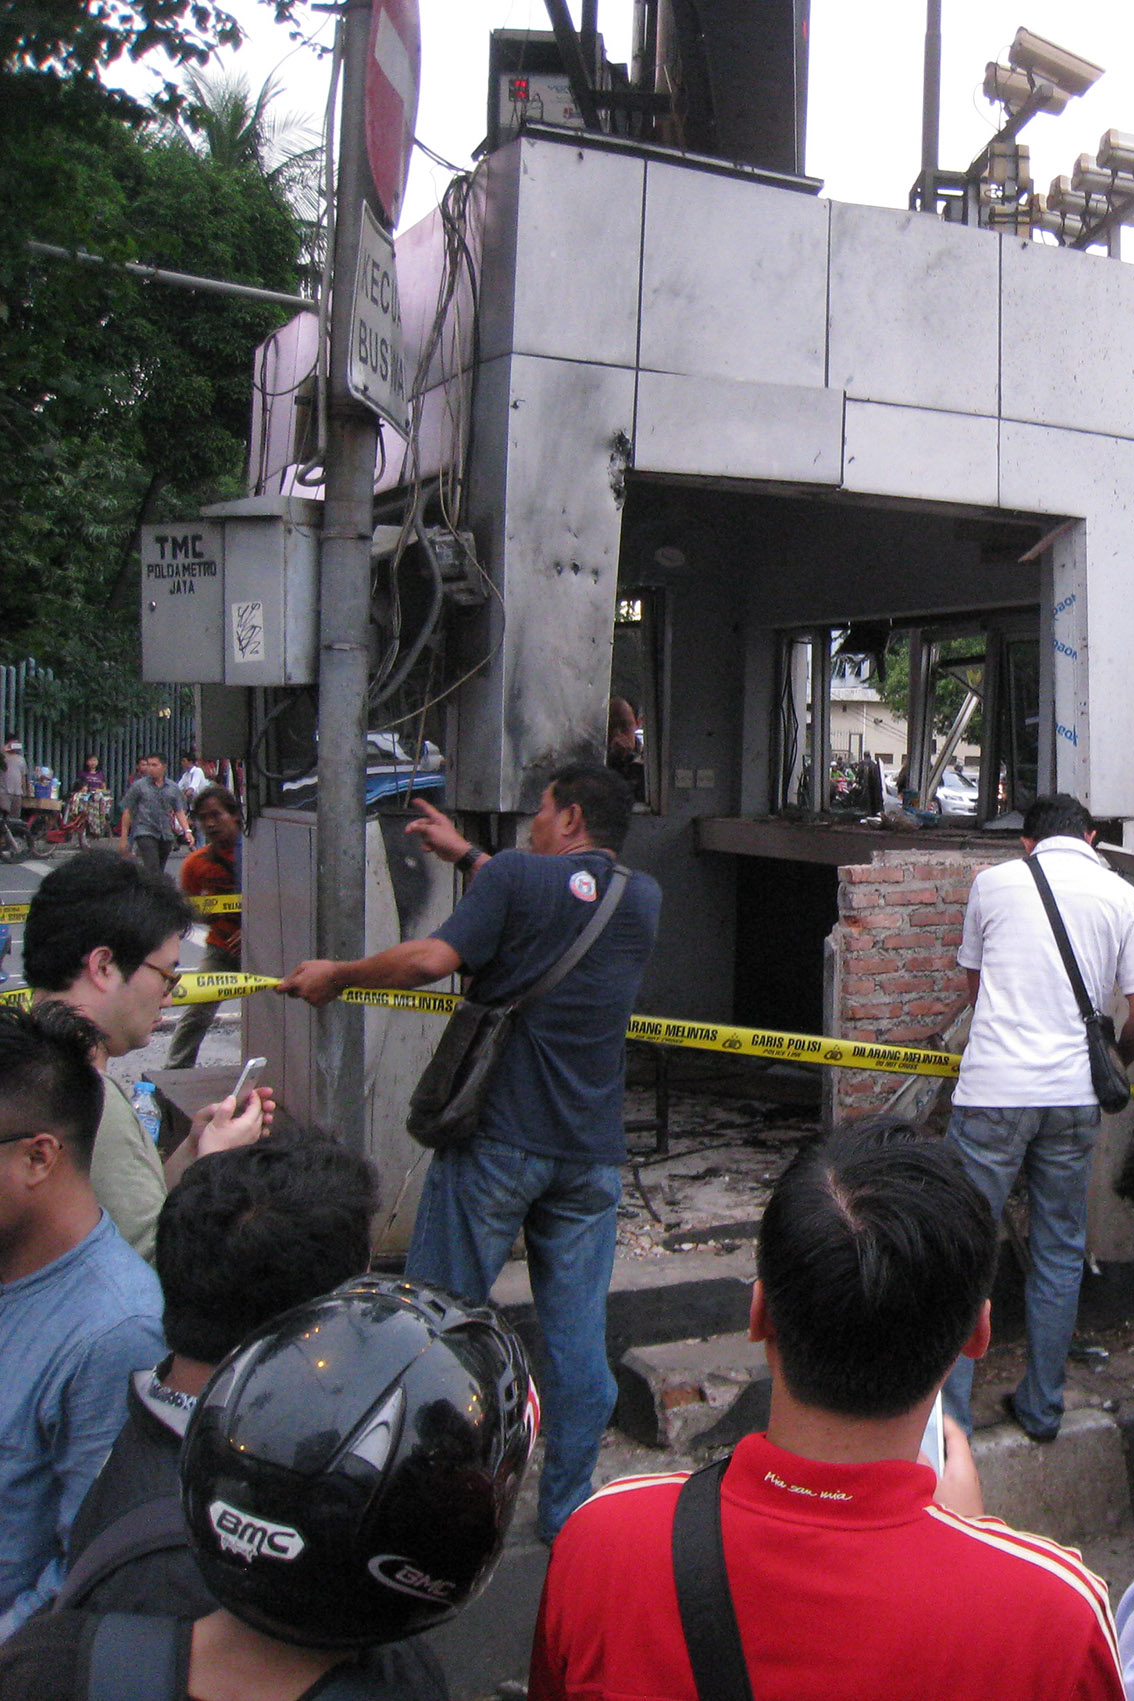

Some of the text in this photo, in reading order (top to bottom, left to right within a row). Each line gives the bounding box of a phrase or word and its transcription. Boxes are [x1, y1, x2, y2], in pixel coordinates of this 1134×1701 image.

[155, 534, 204, 559] TMC
[169, 580, 195, 594] JAYA
[196, 975, 238, 987] GARIS
[393, 993, 453, 1013] MELINTAS
[665, 1024, 718, 1042] MELINTAS
[752, 1034, 784, 1049] GARIS
[787, 1038, 822, 1053] POLISI
[852, 1045, 900, 1061] DILARANG
[902, 1052, 950, 1066] MELINTAS
[764, 1471, 786, 1488] Mia
[820, 1490, 853, 1501] mia
[394, 1563, 457, 1596] BMC
